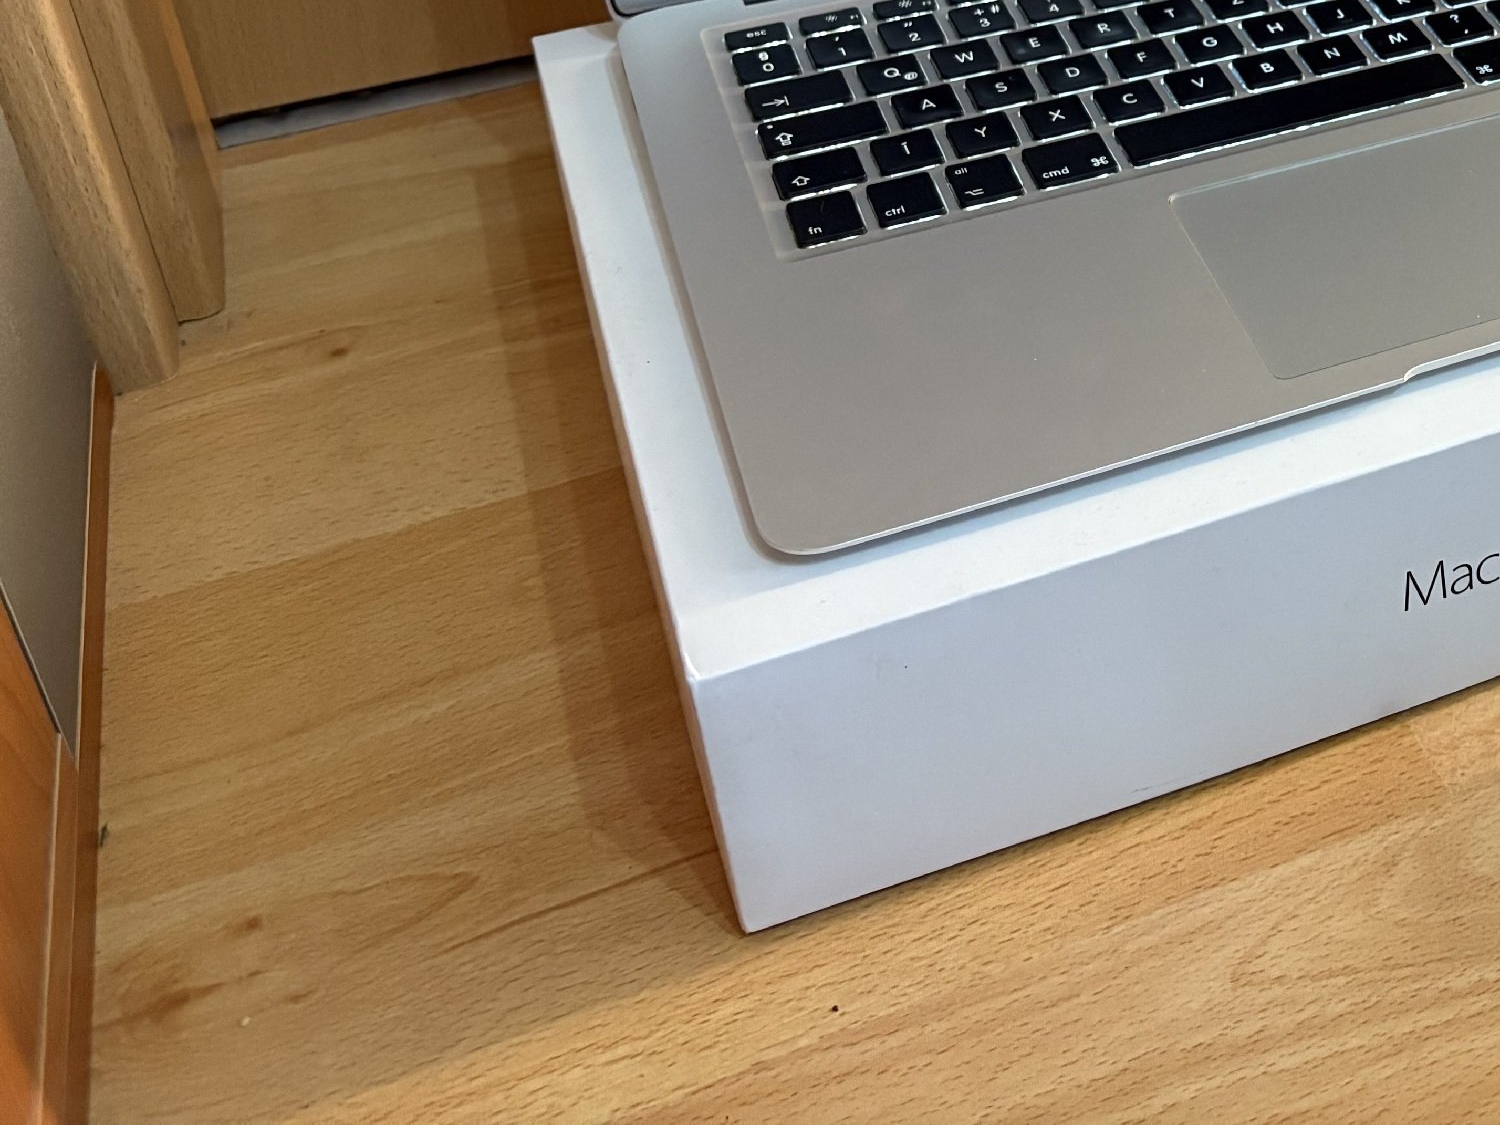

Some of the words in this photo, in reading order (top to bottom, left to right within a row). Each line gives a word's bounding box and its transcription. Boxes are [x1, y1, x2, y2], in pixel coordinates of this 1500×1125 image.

[1043, 166, 1069, 179] cmd
[885, 206, 905, 217] ctrl
[809, 225, 823, 235] fn
